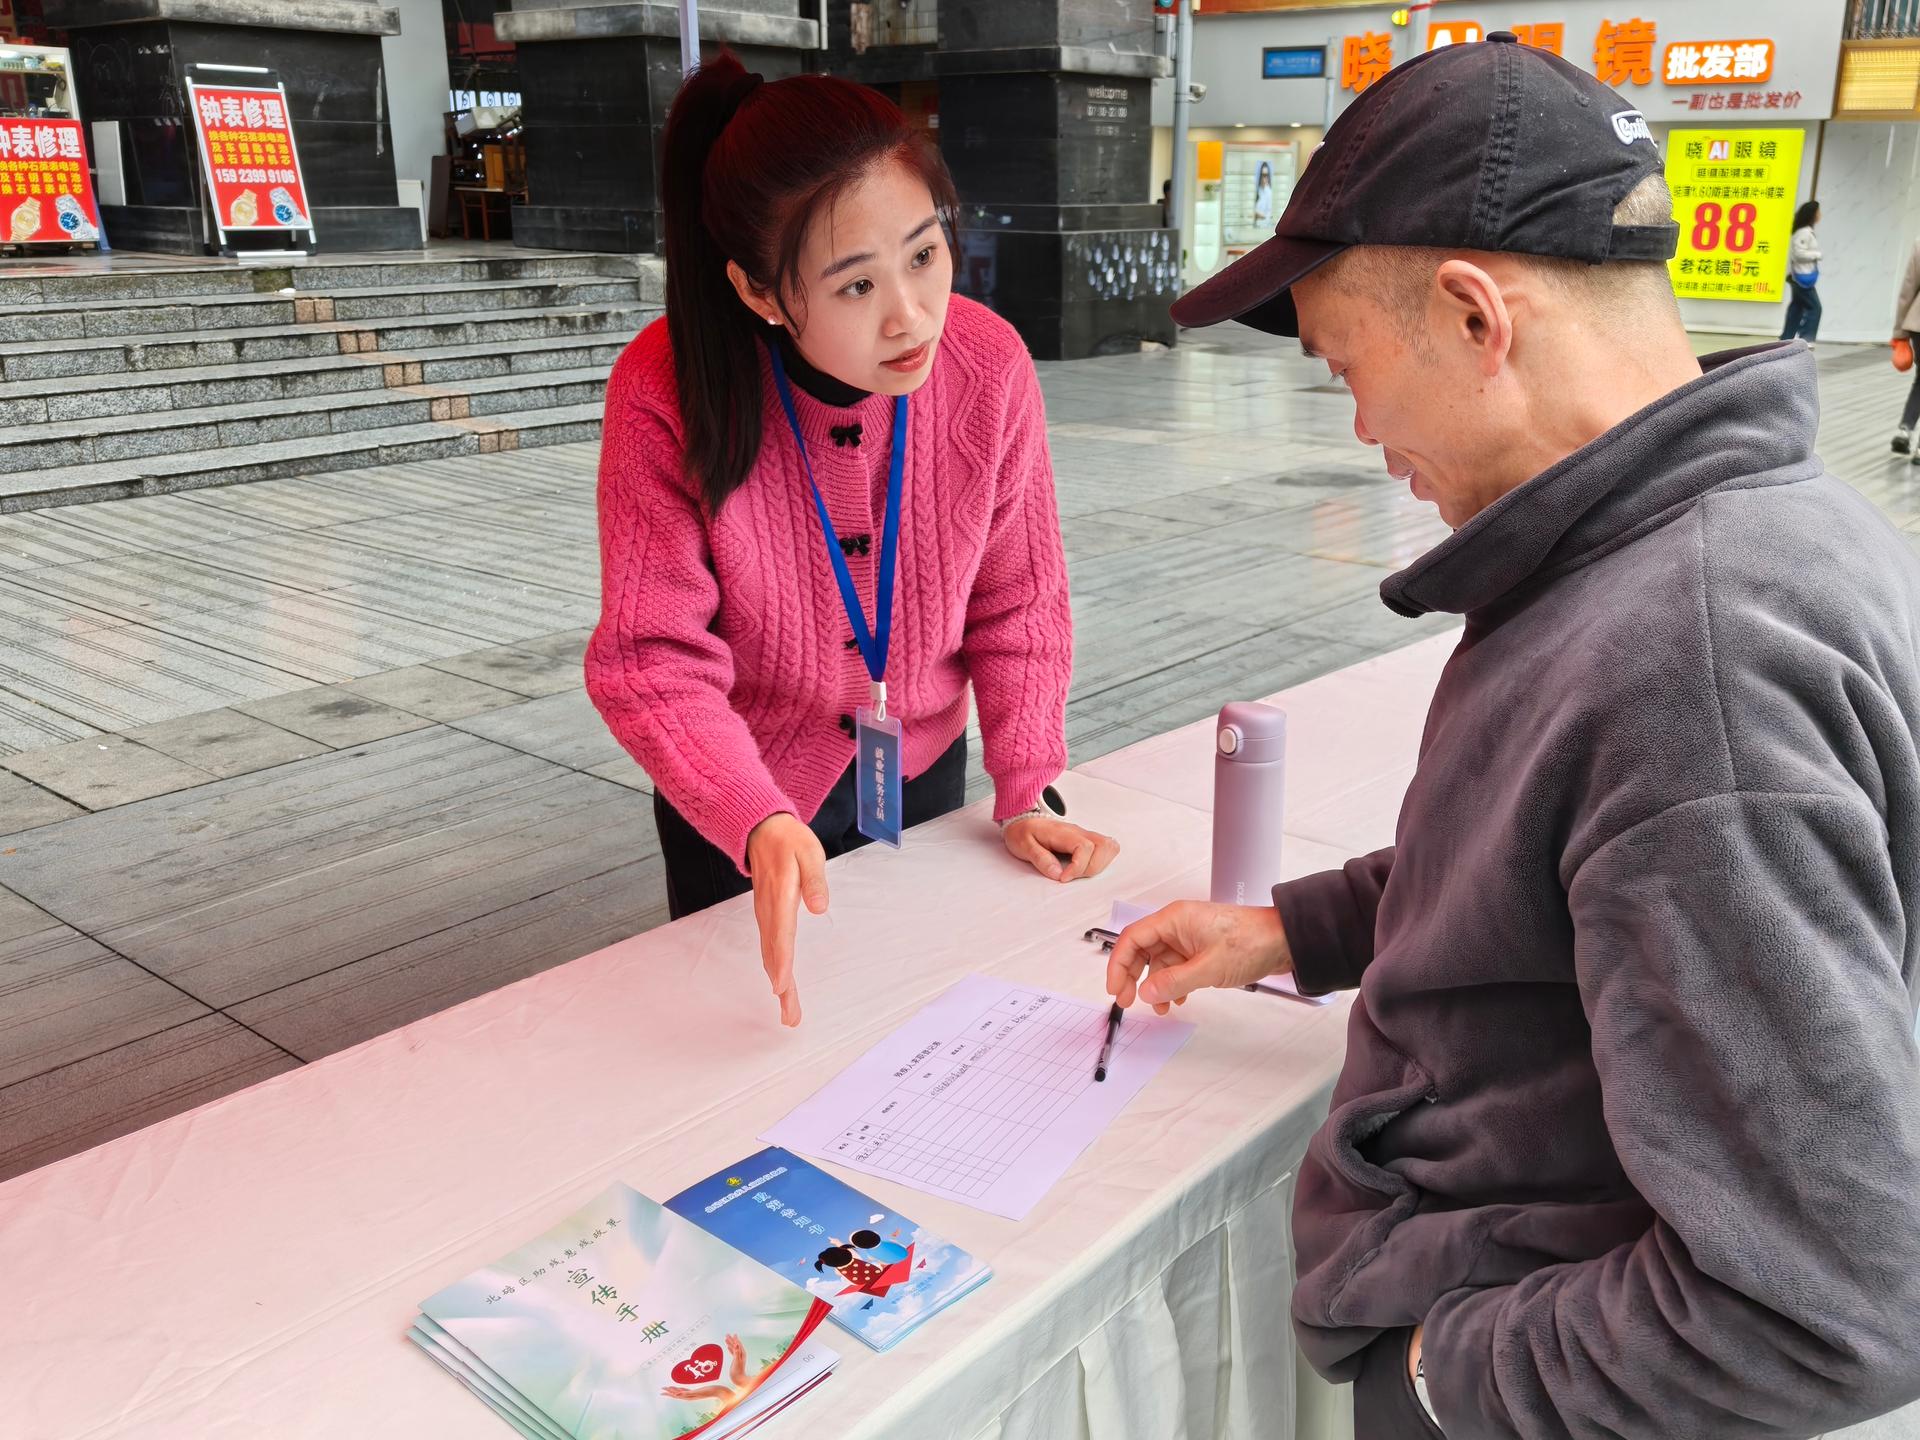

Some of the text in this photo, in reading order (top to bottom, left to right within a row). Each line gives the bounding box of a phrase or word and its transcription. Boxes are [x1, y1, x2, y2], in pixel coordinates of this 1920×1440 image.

[1667, 44, 1769, 80] 批发部
[1087, 86, 1128, 100] welcome
[1672, 91, 1802, 111] 一副也是批发价
[200, 95, 286, 128] 钟表修理
[1685, 140, 1777, 160] 晓AI眼镜
[216, 168, 296, 183] 159 2399 9106
[1680, 258, 1760, 276] 老花镜5元
[567, 1268, 670, 1344] 宣传手册
